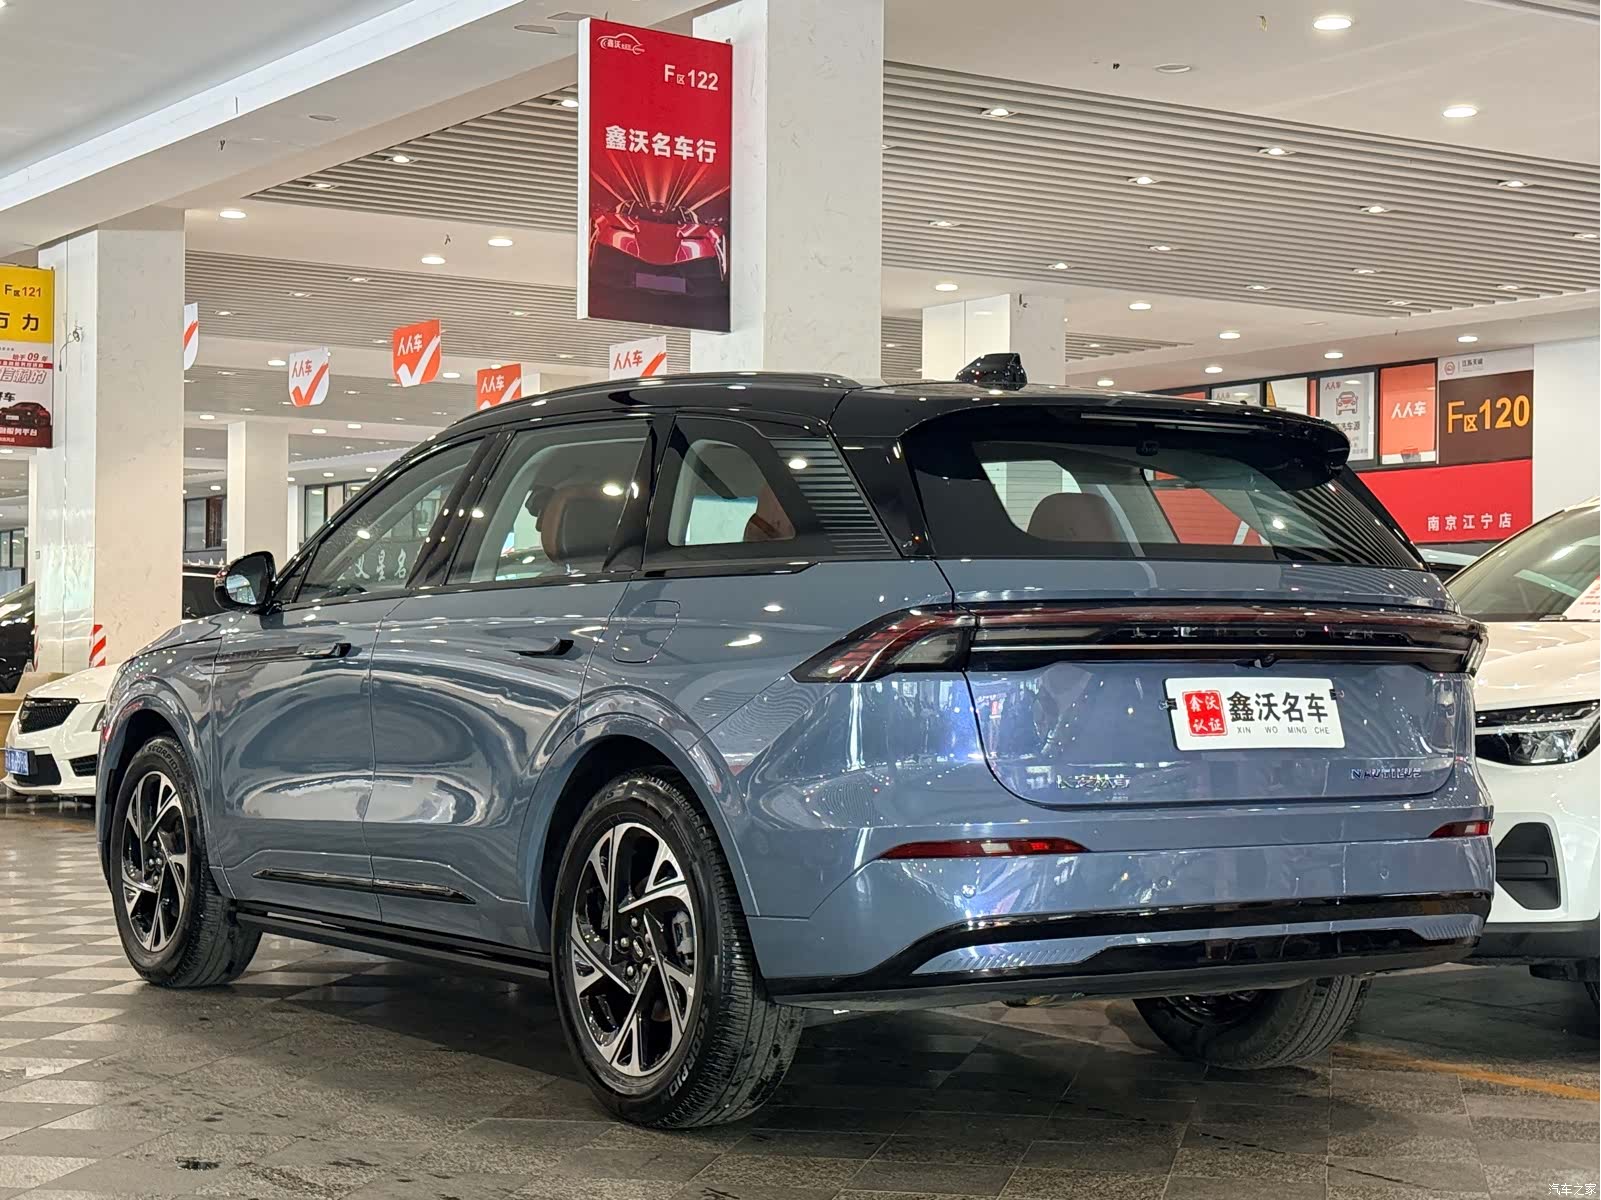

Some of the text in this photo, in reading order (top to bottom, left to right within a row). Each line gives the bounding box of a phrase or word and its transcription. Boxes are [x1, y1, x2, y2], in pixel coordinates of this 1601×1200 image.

[664, 64, 719, 91] F区122
[605, 125, 717, 163] 鑫沃名车行
[4, 284, 42, 298] F区121
[397, 333, 423, 356] 人人车
[291, 359, 313, 378] 人人车
[614, 350, 643, 370] 人人车
[480, 374, 505, 394] 人人车
[1391, 400, 1427, 419] 人人车
[1447, 394, 1531, 433] F区120
[1427, 512, 1512, 532] 南京江宁店
[1227, 691, 1329, 723] 鑫沃名车
[1237, 726, 1331, 735] XIN WO MING CHE
